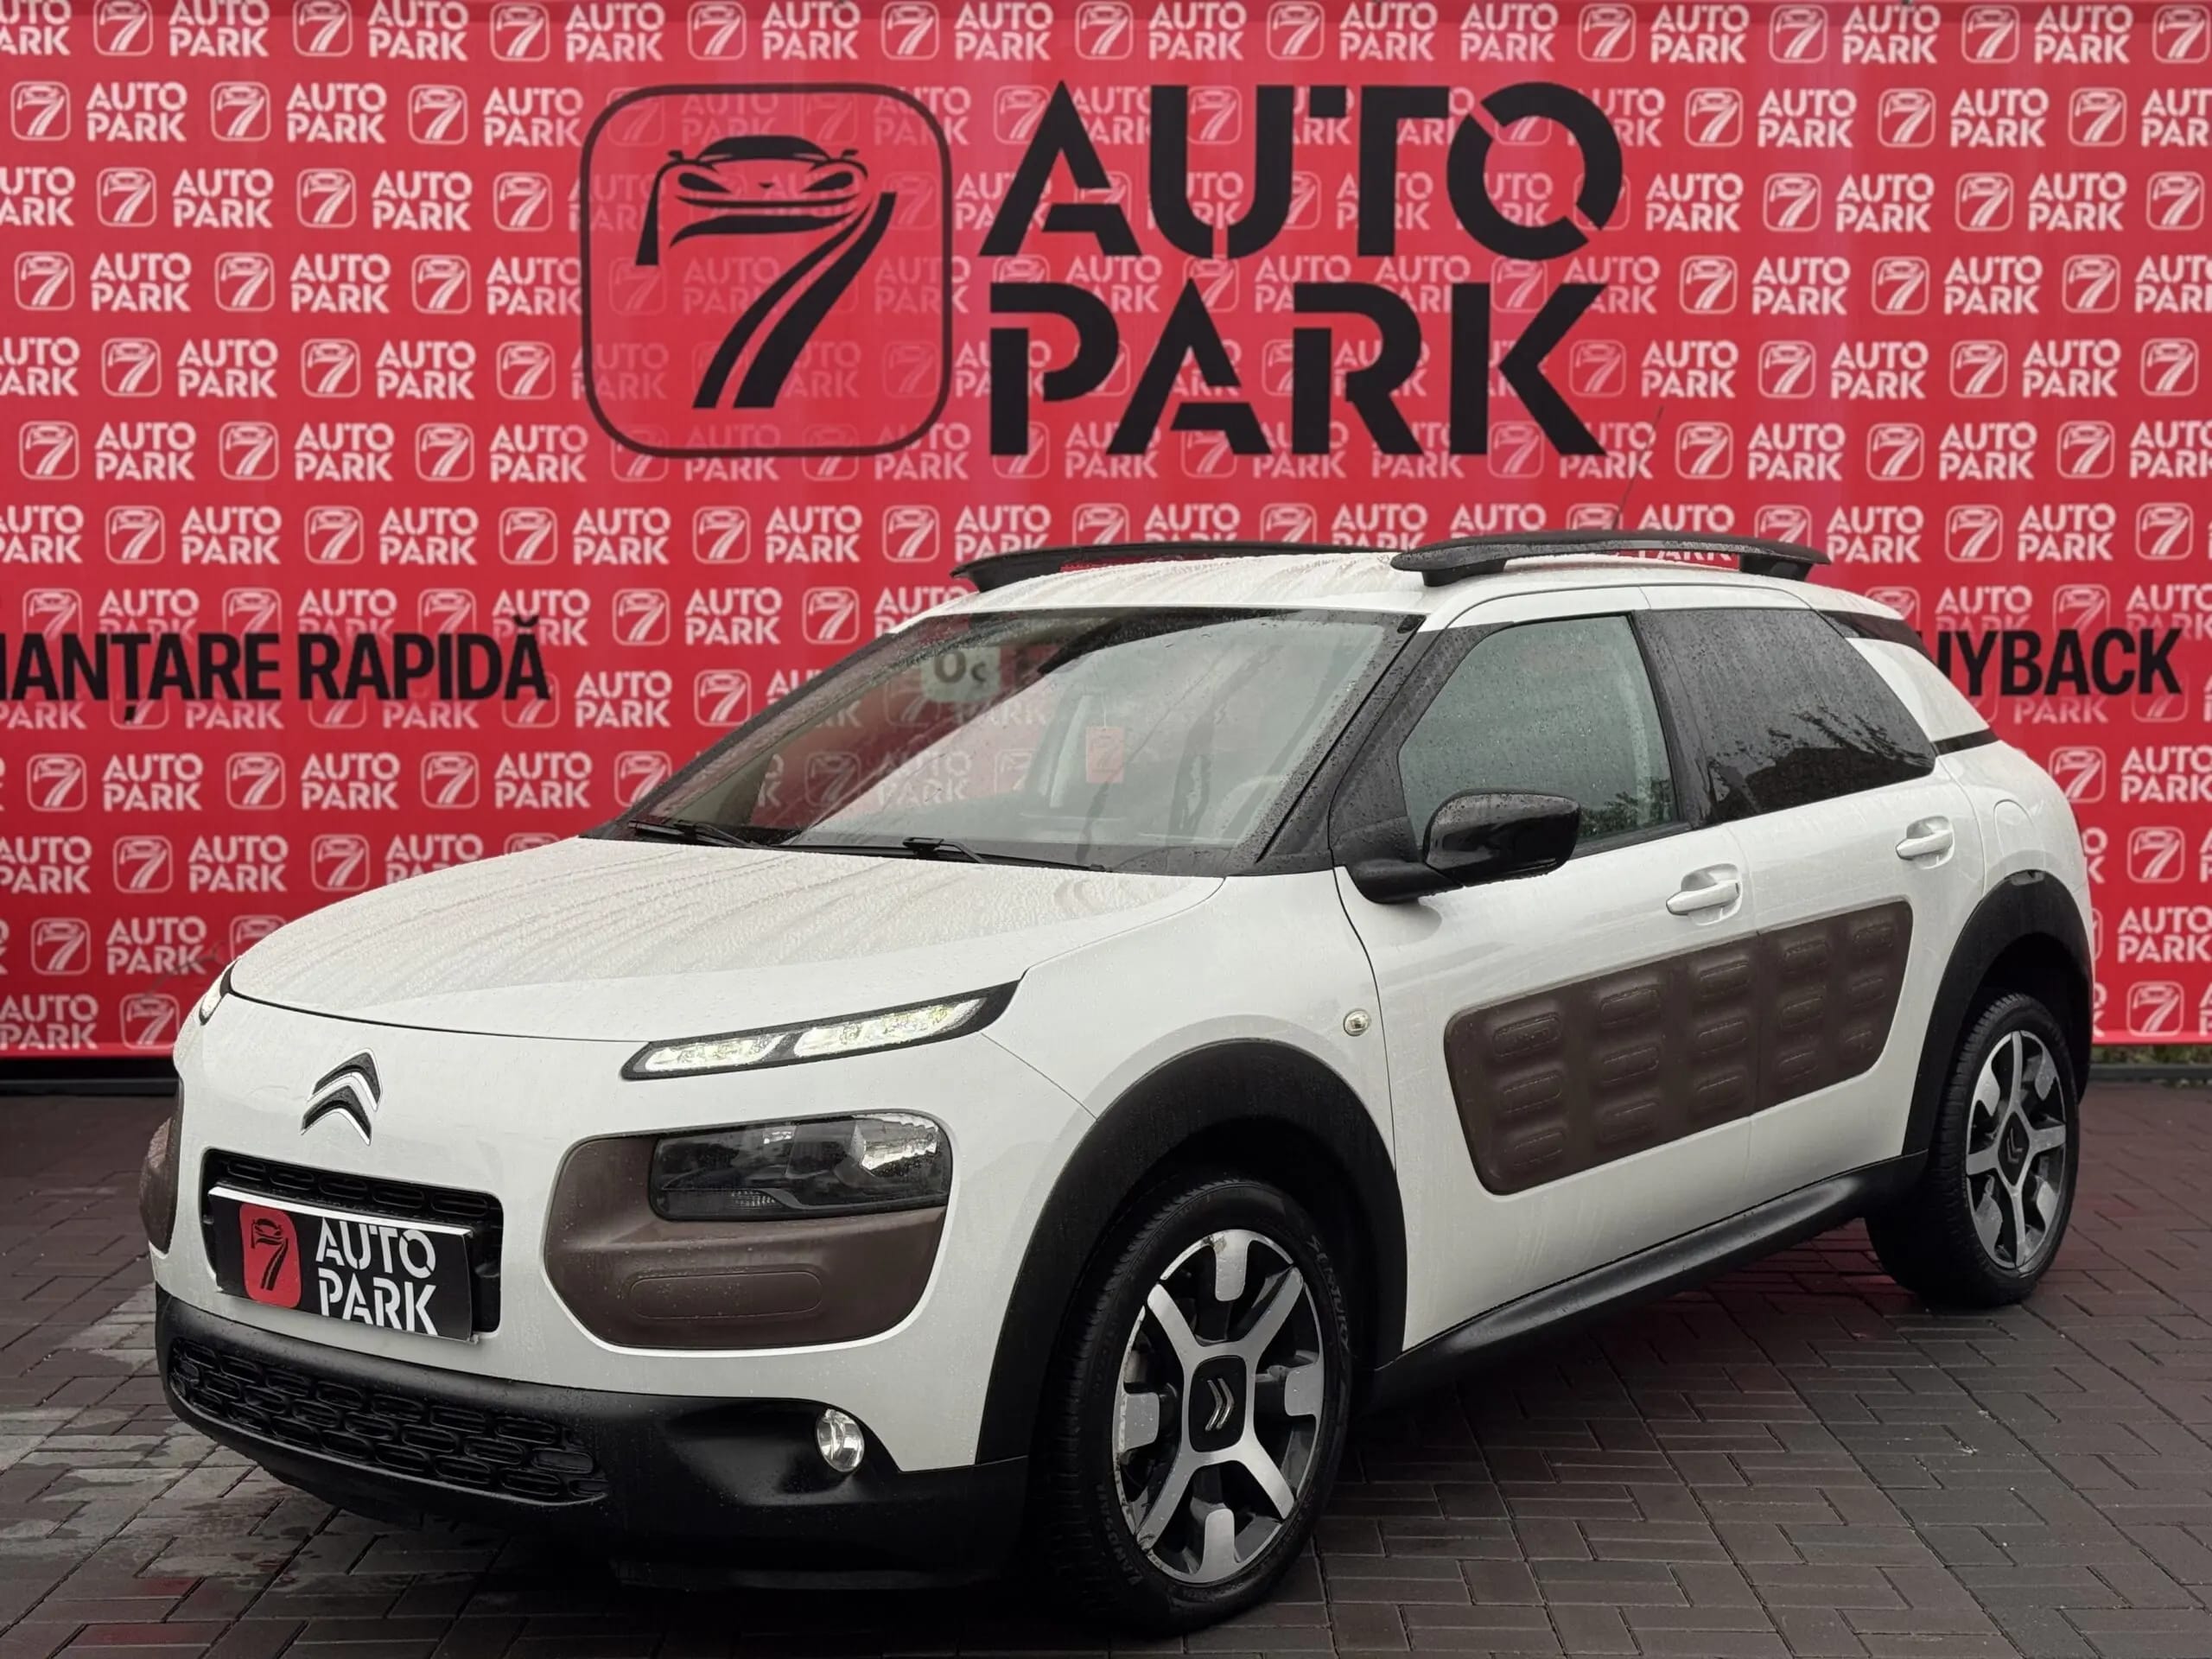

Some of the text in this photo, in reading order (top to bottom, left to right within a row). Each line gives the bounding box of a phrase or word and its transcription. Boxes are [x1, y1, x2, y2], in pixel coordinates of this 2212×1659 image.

[168, 0, 268, 25] AUTO
[368, 1, 468, 30] AUTO
[564, 2, 665, 31] AUTO
[761, 0, 860, 29] AUTO
[954, 2, 1052, 30] AUTO
[1147, 2, 1246, 30] AUTO
[1339, 2, 1437, 30] AUTO
[1460, 2, 1557, 31] AUTO
[1650, 3, 1748, 33] AUTO
[1842, 5, 1940, 34] AUTO
[2034, 4, 2132, 33] AUTO
[169, 27, 268, 56] PARK
[369, 31, 467, 60] PARK
[565, 32, 664, 61] PARK
[762, 30, 859, 60] PARK
[955, 31, 1052, 60] PARK
[1148, 31, 1245, 60] PARK
[1340, 31, 1436, 60] PARK
[1461, 32, 1556, 61] PARK
[1651, 34, 1747, 63] PARK
[1843, 35, 1939, 64] PARK
[2035, 34, 2131, 62] PARK
[86, 81, 188, 111] AUTO
[285, 83, 387, 112] AUTO
[483, 86, 582, 116] AUTO
[1757, 88, 1856, 118] AUTO
[1950, 88, 2048, 117] AUTO
[86, 111, 187, 142] PARK
[287, 113, 385, 143] PARK
[484, 117, 582, 146] PARK
[1758, 118, 1855, 149] PARK
[1951, 118, 2047, 147] PARK
[173, 168, 274, 197] AUTO
[979, 79, 1624, 260] AUTO
[372, 171, 473, 200] AUTO
[1644, 173, 1743, 201] AUTO
[1835, 173, 1934, 202] AUTO
[2028, 171, 2126, 200] AUTO
[173, 198, 273, 227] PARK
[372, 200, 472, 230] PARK
[1645, 202, 1742, 232] PARK
[1836, 203, 1933, 233] PARK
[2029, 201, 2125, 231] PARK
[90, 252, 192, 281] AUTO
[289, 253, 391, 283] AUTO
[486, 256, 585, 285] AUTO
[1065, 254, 1162, 282] AUTO
[1254, 254, 1351, 283] AUTO
[1374, 254, 1471, 283] AUTO
[1562, 255, 1660, 284] AUTO
[1751, 256, 1849, 285] AUTO
[1943, 256, 2042, 284] AUTO
[91, 282, 190, 311] PARK
[290, 283, 390, 314] PARK
[486, 286, 584, 315] PARK
[1752, 286, 1848, 315] PARK
[1944, 285, 2041, 315] PARK
[0, 337, 81, 365] UTO
[176, 339, 278, 367] AUTO
[375, 340, 476, 369] AUTO
[1641, 340, 1738, 368] AUTO
[1830, 340, 1928, 369] AUTO
[2022, 339, 2120, 367] AUTO
[990, 277, 1608, 455] PARK
[178, 368, 276, 397] PARK
[376, 370, 475, 399] PARK
[1642, 369, 1737, 397] PARK
[1831, 370, 1927, 398] PARK
[2023, 368, 2119, 397] PARK
[95, 422, 196, 450] AUTO
[294, 422, 395, 451] AUTO
[489, 423, 588, 452] AUTO
[1747, 422, 1845, 450] AUTO
[1938, 422, 2037, 450] AUTO
[95, 451, 195, 480] PARK
[295, 452, 394, 481] PARK
[490, 453, 587, 481] PARK
[683, 453, 780, 483] PARK
[874, 451, 970, 480] PARK
[1065, 450, 1160, 479] PARK
[1252, 450, 1348, 480] PARK
[1371, 450, 1466, 479] PARK
[1559, 450, 1655, 480] PARK
[1748, 451, 1844, 480] PARK
[1939, 451, 2036, 480] PARK
[0, 505, 84, 533] UTO
[180, 505, 282, 534] AUTO
[378, 506, 478, 535] AUTO
[572, 506, 671, 535] AUTO
[765, 505, 862, 533] AUTO
[954, 504, 1051, 532] AUTO
[1145, 504, 1240, 531] AUTO
[1332, 504, 1428, 531] AUTO
[1451, 503, 1547, 531] AUTO
[1637, 504, 1735, 531] AUTO
[1826, 505, 1923, 533] AUTO
[2017, 503, 2115, 531] AUTO
[181, 535, 280, 563] PARK
[379, 536, 477, 564] PARK
[573, 536, 670, 564] PARK
[766, 534, 861, 563] PARK
[1827, 534, 1923, 563] PARK
[2018, 532, 2114, 561] PARK
[99, 588, 200, 615] AUTO
[296, 588, 397, 615] AUTO
[491, 588, 590, 616] AUTO
[684, 587, 782, 615] AUTO
[1935, 586, 2032, 613] AUTO
[685, 616, 781, 645] PARK
[299, 614, 550, 702] RAPIDĂ
[574, 670, 672, 698] AUTO
[185, 700, 283, 730] PARK
[382, 700, 480, 729] PARK
[575, 699, 671, 728] PARK
[2012, 695, 2110, 725] PARK
[102, 753, 203, 781] AUTO
[301, 752, 399, 779] AUTO
[493, 751, 592, 779] AUTO
[2120, 745, 2212, 772] AUTO
[103, 782, 202, 810] PARK
[302, 781, 398, 809] PARK
[494, 780, 591, 808] PARK
[2120, 774, 2212, 802] PARK
[188, 835, 289, 862] AUTO
[385, 833, 482, 861] AUTO
[188, 864, 288, 892] PARK
[105, 916, 207, 944] AUTO
[2116, 906, 2212, 933] AUTO
[106, 945, 206, 974] PARK
[2117, 935, 2212, 963] PARK
[0, 994, 99, 1021] AUTO
[0, 1023, 98, 1051] PARK
[315, 1217, 435, 1279] AUTO
[318, 1267, 438, 1336] PARK
